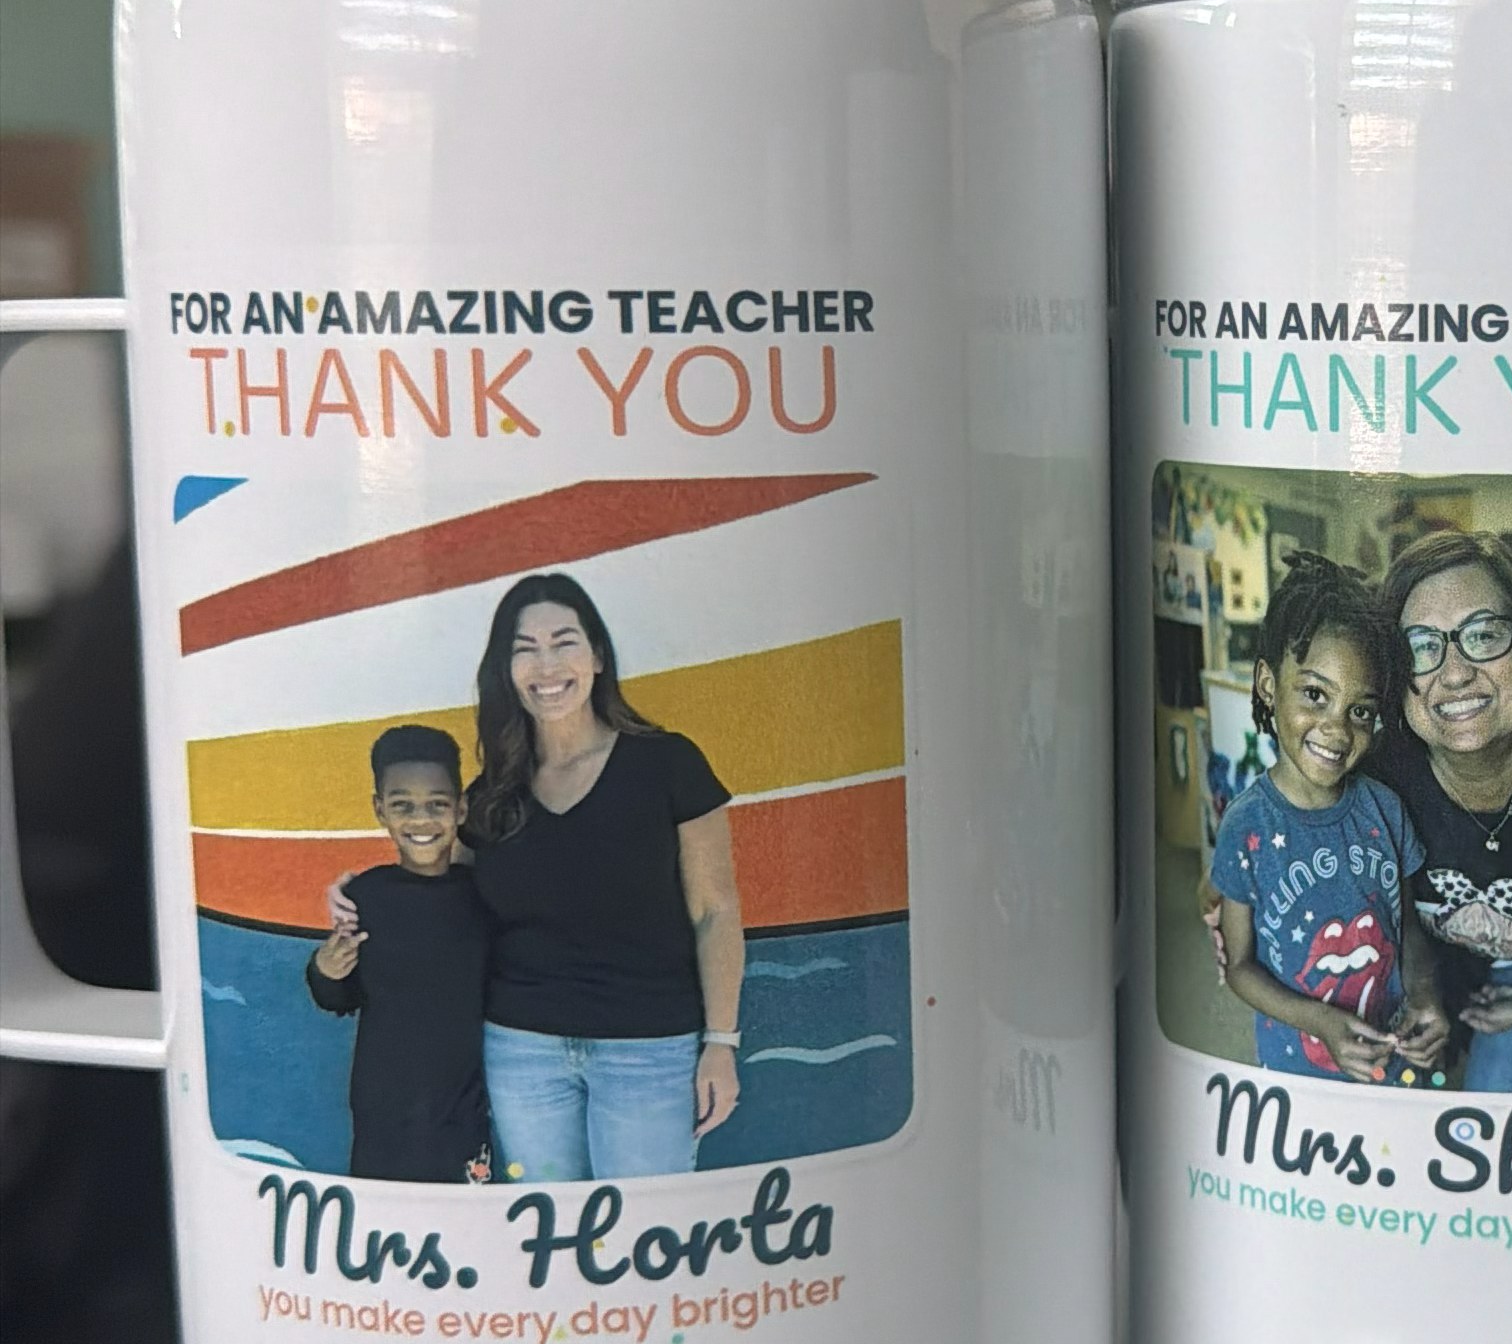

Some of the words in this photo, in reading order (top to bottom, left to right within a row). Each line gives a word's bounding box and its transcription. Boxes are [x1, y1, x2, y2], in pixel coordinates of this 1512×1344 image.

[172, 292, 231, 334] FOR
[242, 291, 304, 334] AN
[317, 290, 593, 334] AMAZING
[607, 290, 875, 334] TEACHER
[1156, 300, 1206, 339] FOR
[1215, 301, 1267, 341] AN
[1279, 302, 1509, 343] AMAZING
[190, 347, 541, 438] THANK
[578, 345, 837, 438] YOU
[1170, 349, 1460, 435] THANK
[1207, 1072, 1396, 1188] Mrs.
[259, 1174, 479, 1290] Mrs.
[507, 1167, 834, 1289] Horta
[1187, 1163, 1231, 1200] you
[1239, 1181, 1326, 1222] make
[1336, 1203, 1437, 1244] every
[259, 1283, 311, 1321] you
[322, 1297, 426, 1336] make
[569, 1299, 657, 1344] day
[672, 1273, 846, 1332] brighter
